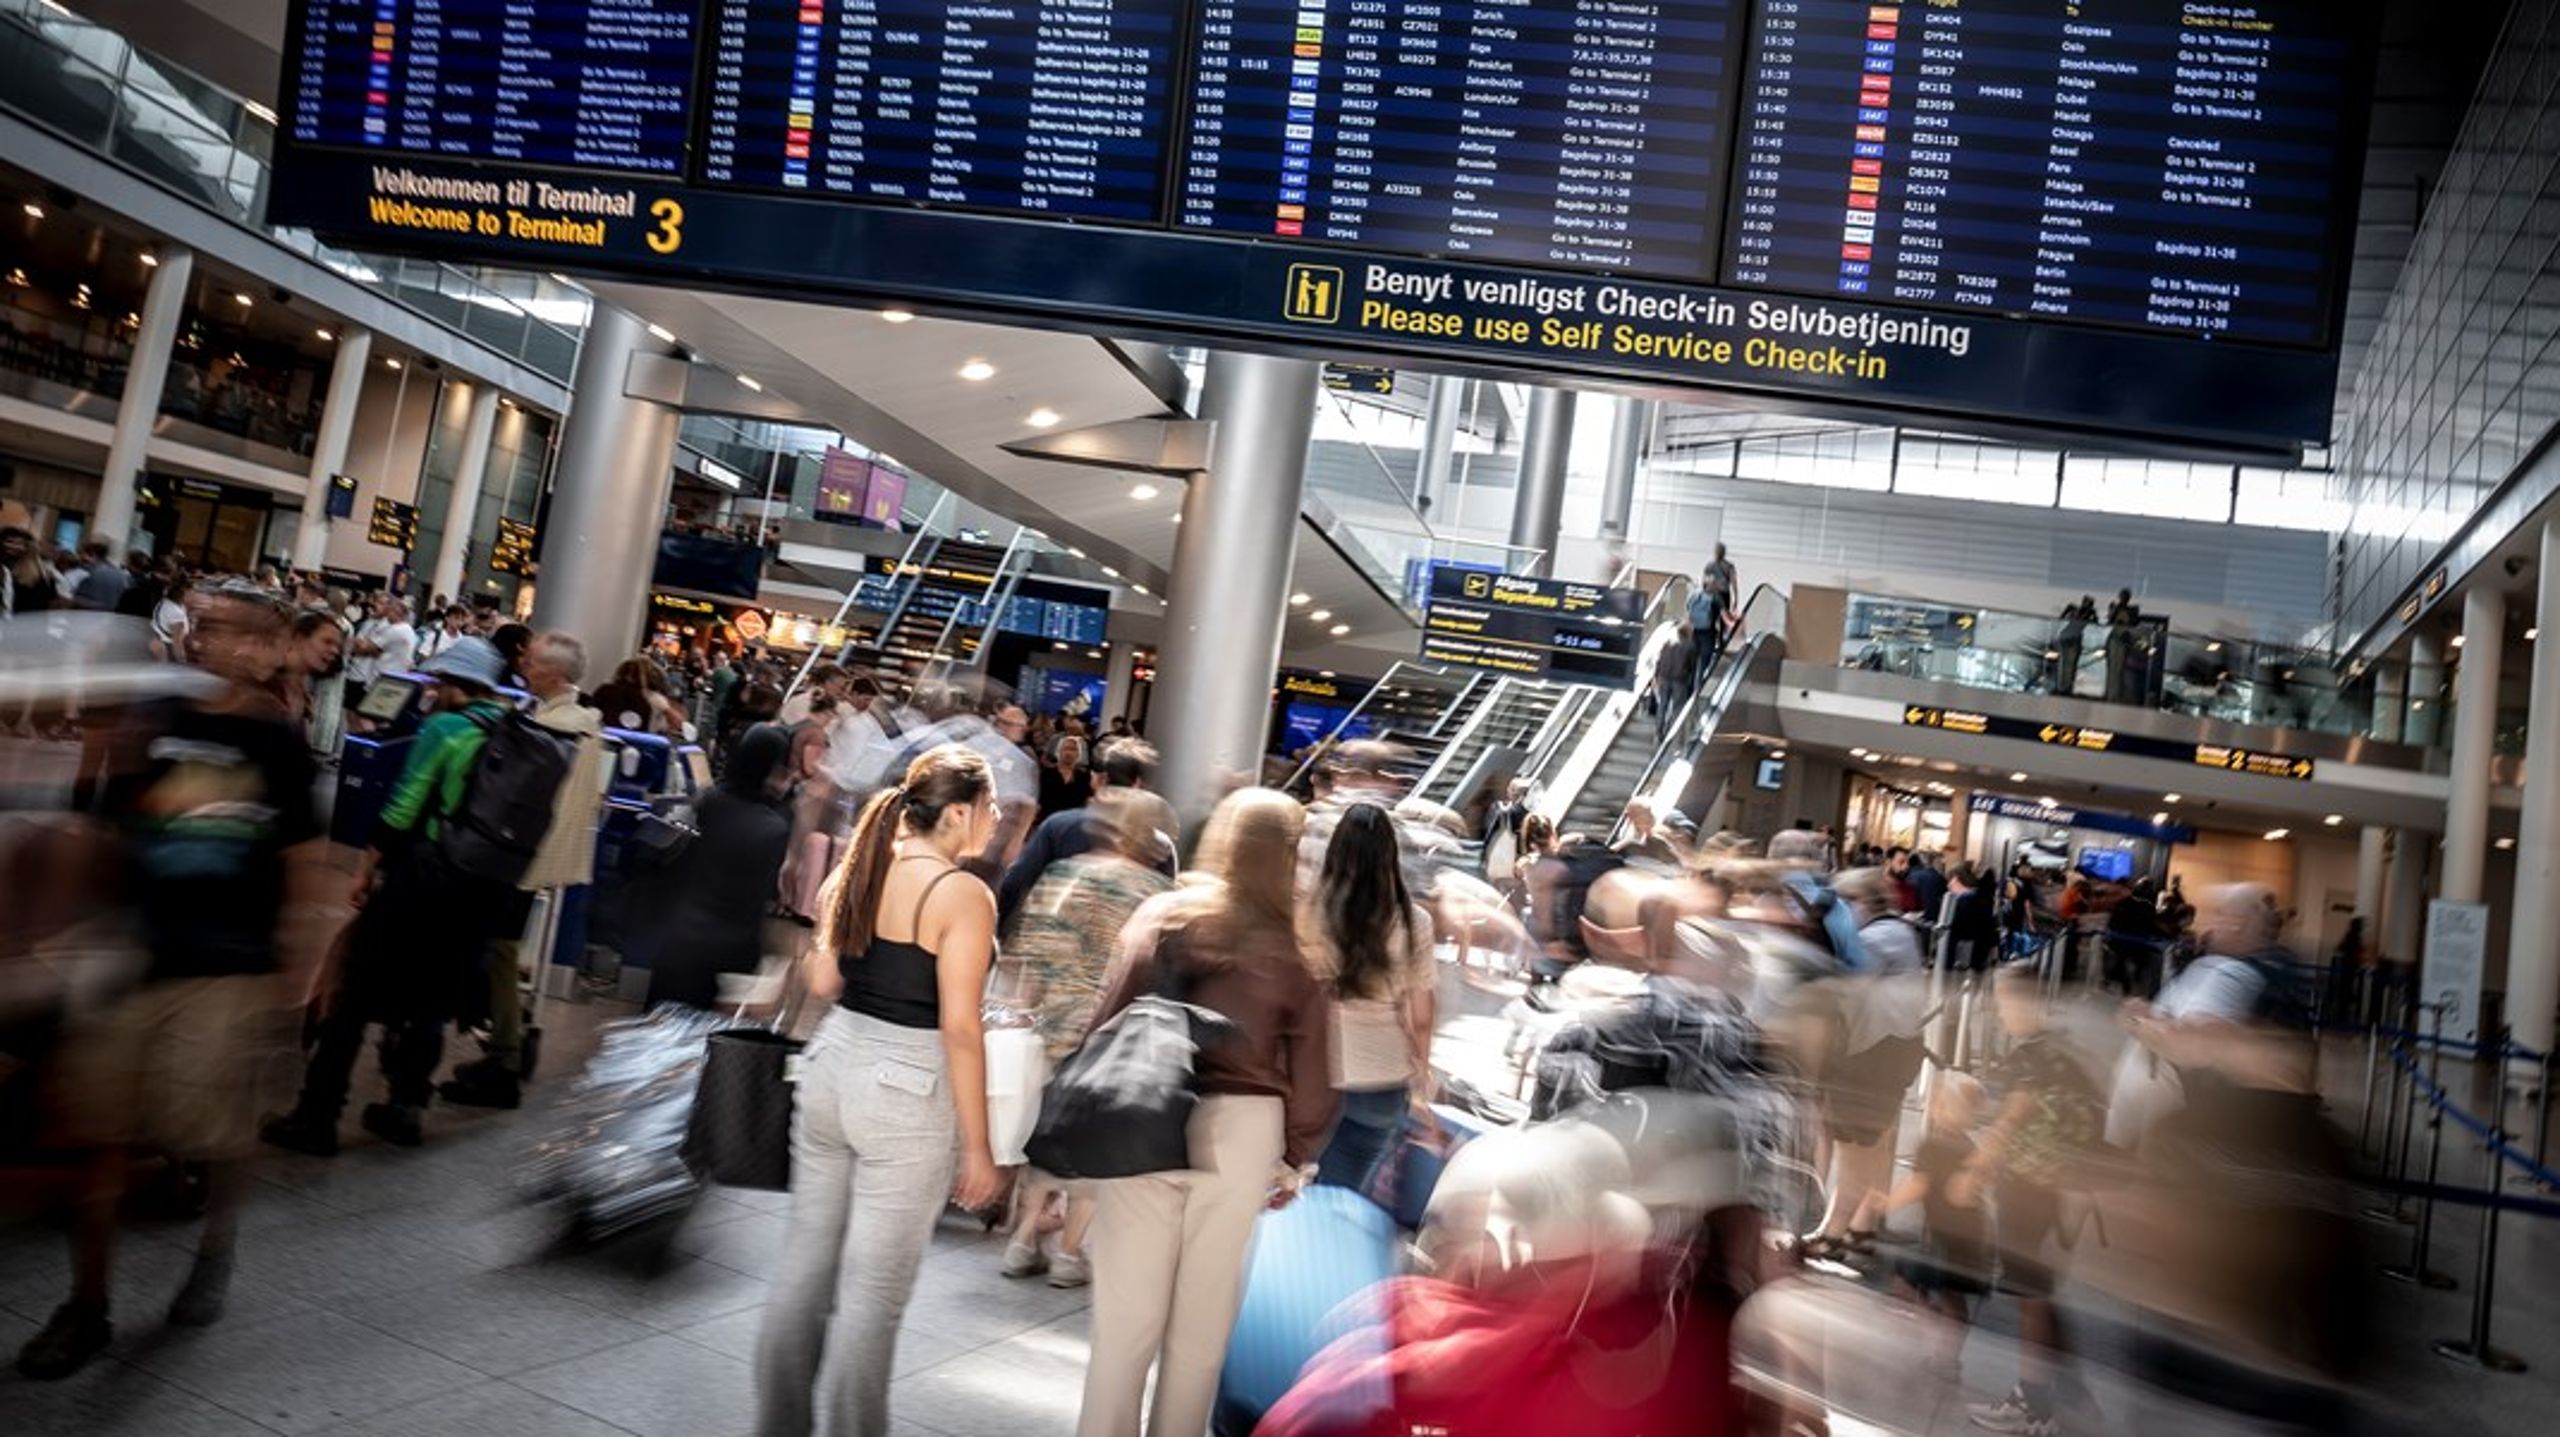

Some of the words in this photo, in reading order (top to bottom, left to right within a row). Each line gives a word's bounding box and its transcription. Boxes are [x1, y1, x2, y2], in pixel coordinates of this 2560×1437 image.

[1473, 9, 1504, 20] Zurich
[2183, 3, 2231, 16] Check-in
[1575, 16, 1590, 27] Go
[1592, 19, 1603, 28] to
[1605, 18, 1648, 31] Terminal
[1649, 22, 1656, 32] 2
[2182, 15, 2230, 27] Check-in
[2062, 41, 2086, 53] Oslo
[2180, 33, 2197, 44] Go
[2198, 35, 2211, 45] to
[2212, 35, 2260, 48] Terminal
[2262, 38, 2270, 50] 2
[2178, 50, 2194, 61] Go
[2196, 52, 2209, 63] to
[2210, 52, 2258, 66] Terminal
[2260, 57, 2268, 68] 2
[2057, 75, 2096, 89] Malaga
[2056, 93, 2087, 105] Dubai
[2053, 110, 2091, 123] Madrid
[2172, 102, 2188, 114] Go
[2190, 104, 2203, 115] to
[2205, 105, 2252, 119] Terminal
[2254, 109, 2262, 121] 2
[1564, 117, 1579, 127] Go
[1581, 119, 1592, 128] to
[1594, 119, 1637, 132] Terminal
[1638, 122, 1646, 133] 2
[2051, 126, 2094, 142] Chicago
[2050, 144, 2079, 156] Basel
[2167, 136, 2220, 151] Cancelled
[2166, 155, 2182, 167] Go
[2184, 157, 2197, 168] to
[2198, 157, 2246, 172] Terminal
[2248, 162, 2256, 173] 2
[373, 166, 499, 204] Velkommen
[505, 180, 530, 207] til
[536, 182, 636, 217] Terminal
[2045, 179, 2084, 193] Malaga
[1453, 190, 1476, 201] Oslo
[2162, 190, 2178, 201] Go
[2180, 192, 2192, 202] to
[2194, 192, 2242, 207] Terminal
[2244, 197, 2252, 209] 2
[369, 196, 471, 232] Welcome
[477, 208, 500, 236] to
[507, 210, 606, 246] Terminal
[646, 198, 684, 254] 3
[2040, 214, 2082, 227] Amman
[1550, 249, 1565, 259] Go
[1567, 251, 1578, 261] to
[1579, 252, 1622, 264] Terminal
[1624, 256, 1631, 266] 2
[2037, 248, 2075, 262] Prague
[2035, 265, 2066, 278] Berlin
[2033, 282, 2071, 297] Bergen
[2151, 277, 2167, 289] Go
[2170, 279, 2182, 290] to
[2184, 279, 2230, 295] Terminal
[2232, 284, 2240, 297] 2
[1364, 265, 1452, 306] Benyt
[1464, 279, 1585, 315] venligst
[1596, 285, 1735, 327] Check-in
[1748, 298, 1971, 356] Selvbetjening
[2030, 300, 2068, 314] Athens
[1361, 302, 1467, 341] Please
[1474, 317, 1530, 343] use
[1541, 317, 1602, 349] Self
[1613, 324, 1732, 365] Service
[1743, 340, 1887, 380] Check-in
[1492, 588, 1558, 608] Departures
